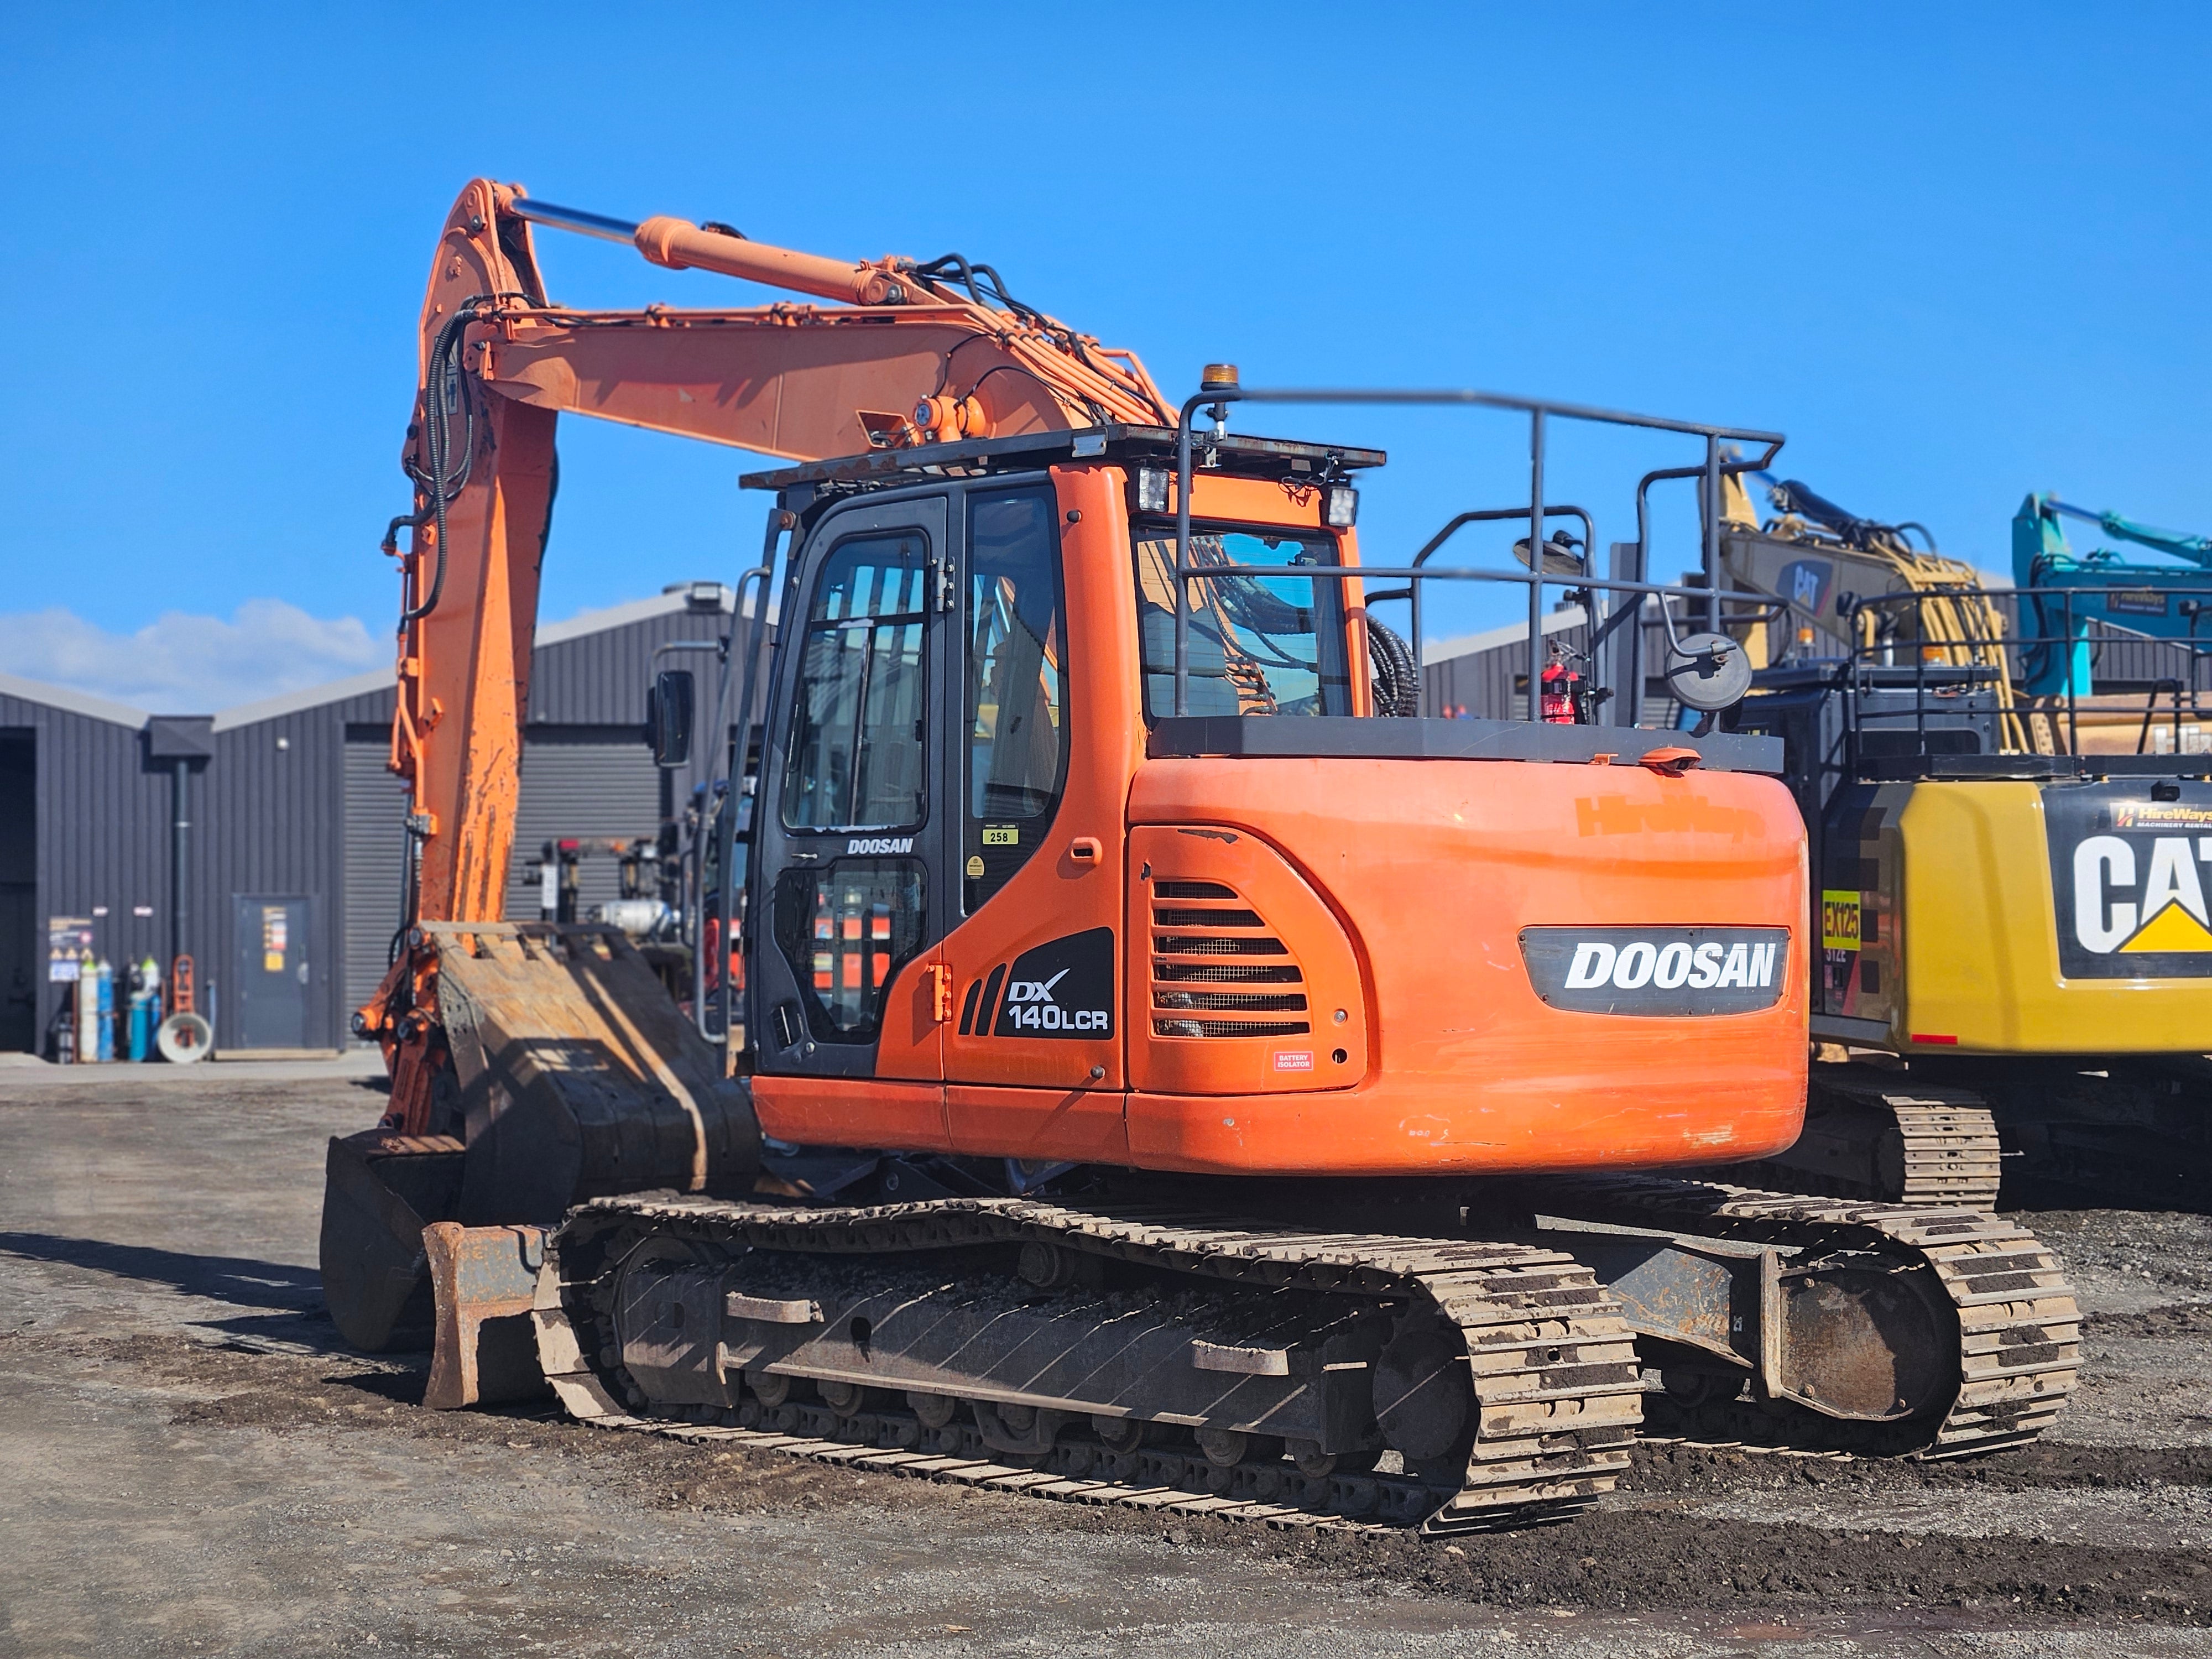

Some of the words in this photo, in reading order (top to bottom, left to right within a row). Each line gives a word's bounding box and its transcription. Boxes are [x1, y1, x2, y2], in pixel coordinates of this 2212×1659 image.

[1794, 565, 1819, 611] CAT
[847, 838, 914, 854] DOOSAN
[990, 832, 1008, 842] 258
[2074, 836, 2212, 953] CA
[1824, 901, 1859, 939] EX125
[1564, 942, 1776, 989] DOOSAN
[1008, 968, 1071, 1001] DX
[1009, 1005, 1108, 1030] 140LCR
